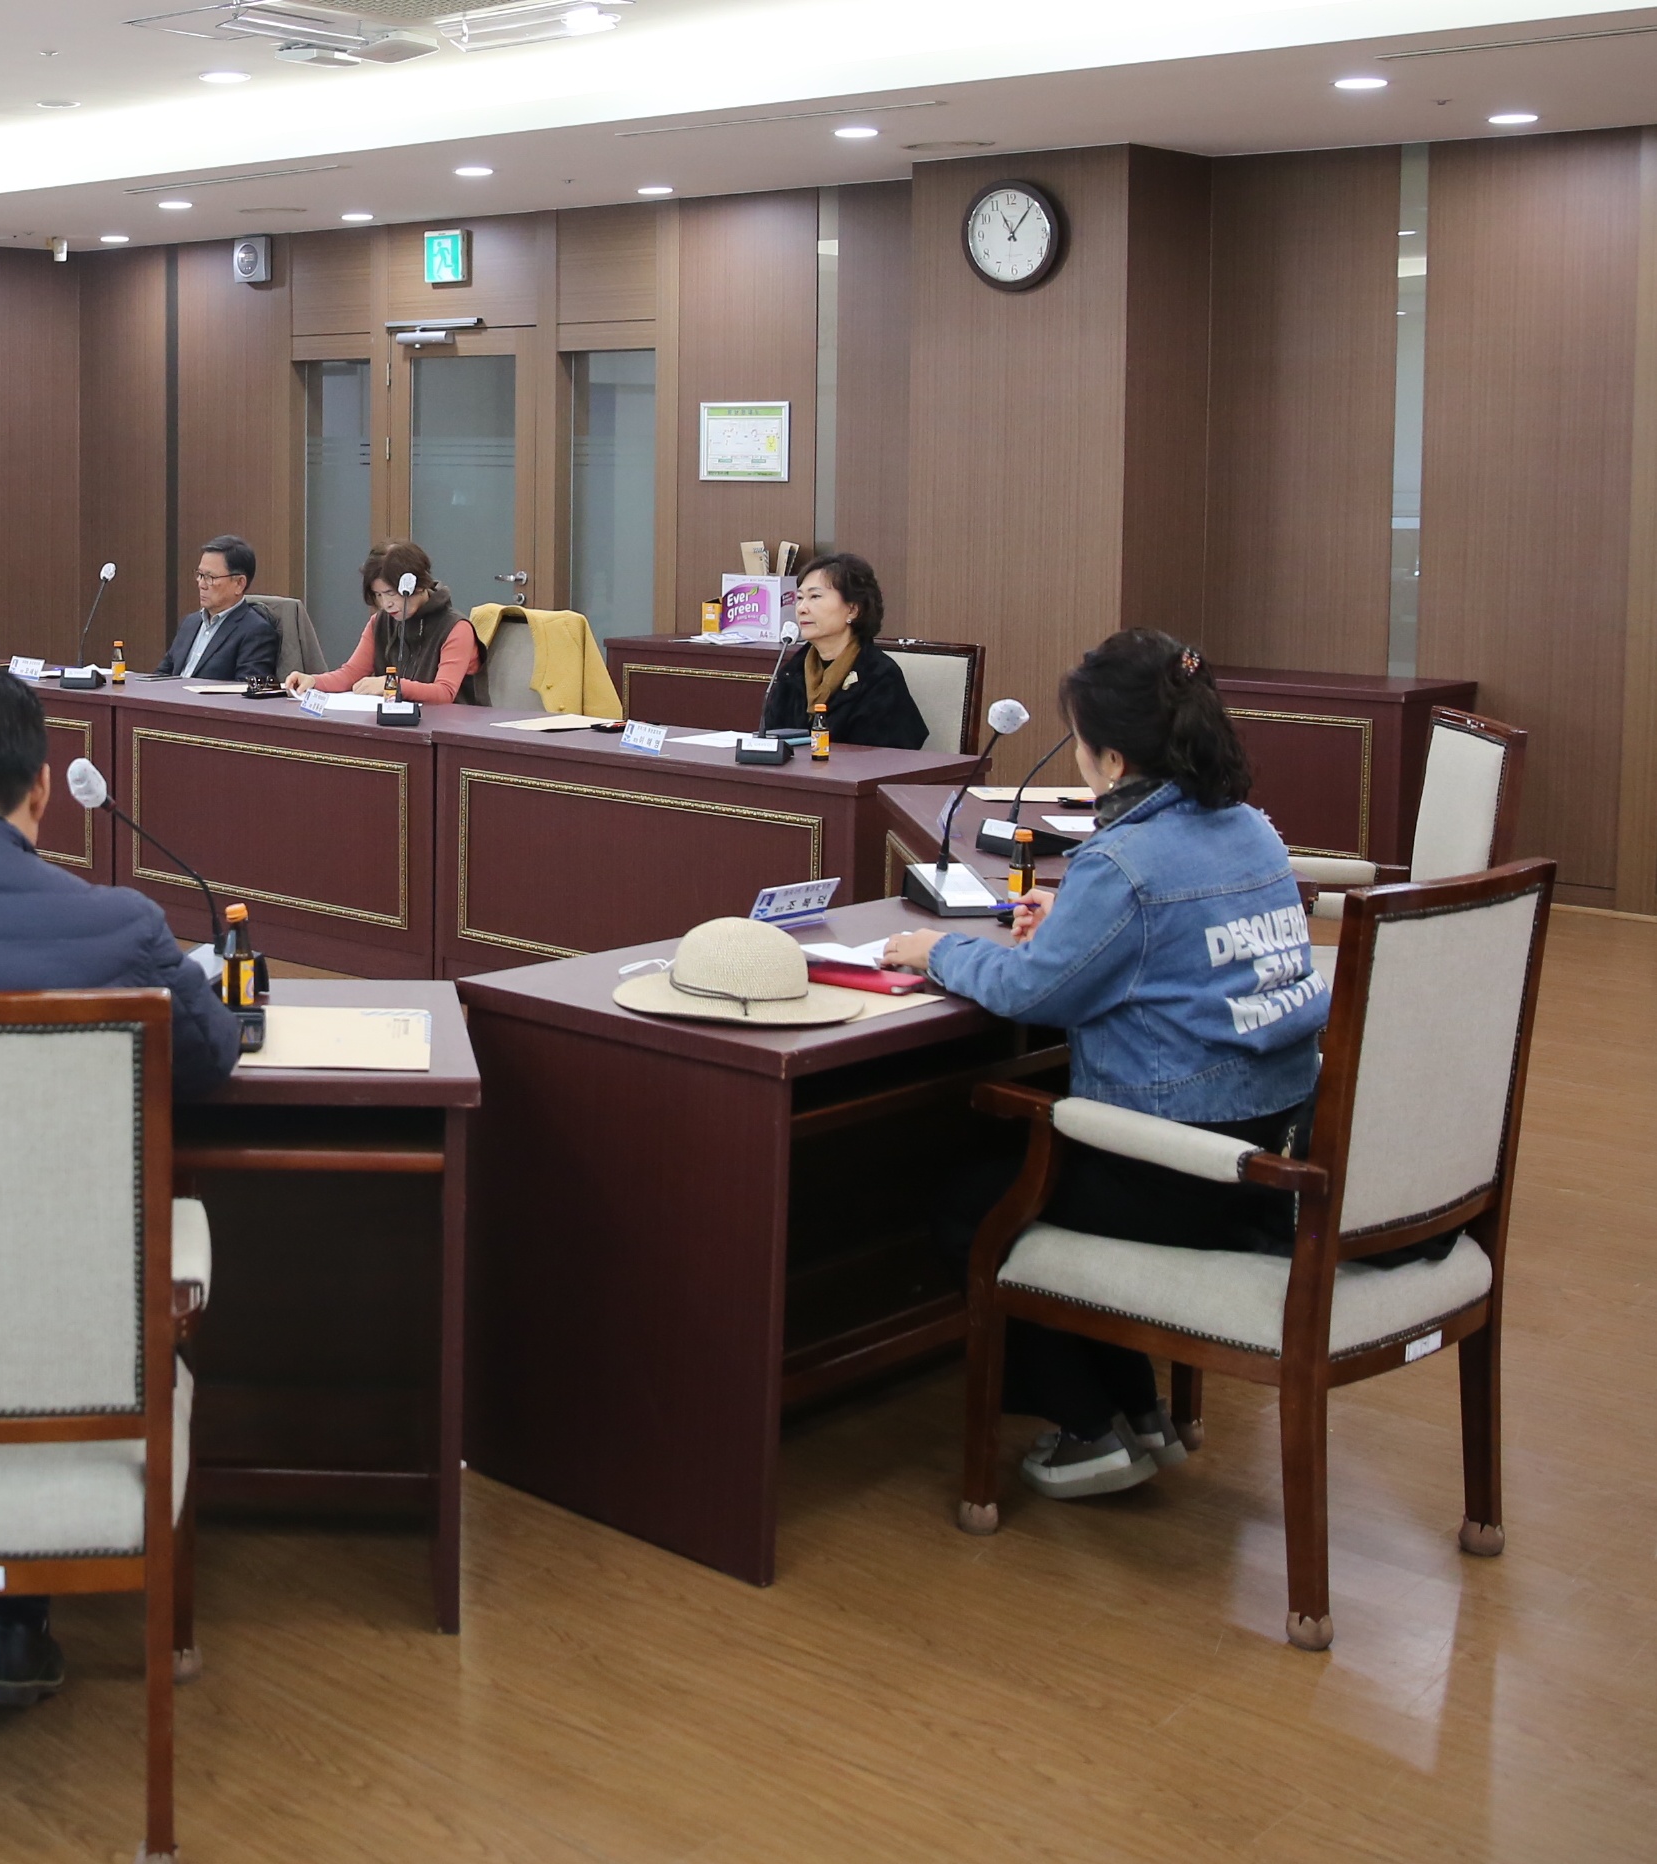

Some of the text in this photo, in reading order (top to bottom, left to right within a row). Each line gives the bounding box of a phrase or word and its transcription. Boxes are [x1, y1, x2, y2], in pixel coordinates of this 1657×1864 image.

[1006, 193, 1017, 206] 12
[991, 200, 999, 212] 11
[980, 213, 991, 225] 10
[978, 230, 985, 242] 9
[983, 247, 990, 260] 8
[1037, 246, 1044, 258] 4
[996, 261, 1002, 273] 7
[1011, 263, 1018, 276] 6
[1027, 259, 1034, 271] 5
[727, 592, 749, 607] Ever
[727, 602, 759, 623] green
[759, 630, 768, 639] A4
